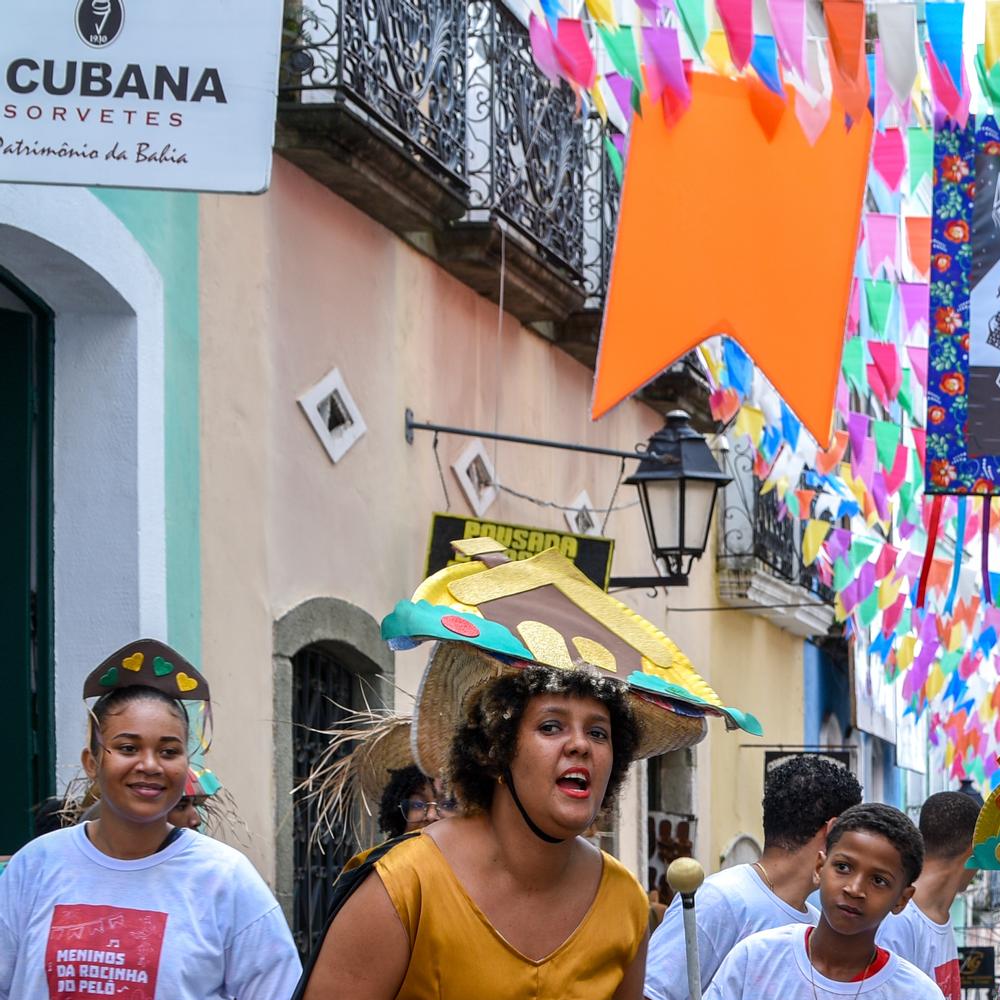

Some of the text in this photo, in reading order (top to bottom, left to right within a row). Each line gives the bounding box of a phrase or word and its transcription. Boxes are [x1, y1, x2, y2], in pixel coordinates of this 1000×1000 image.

[6, 57, 228, 104] CUBANA
[4, 104, 183, 127] SORVETES
[105, 142, 128, 161] da
[136, 142, 189, 164] Bahia
[464, 520, 577, 558] POUSADA
[57, 950, 125, 965] MENINOS
[57, 964, 148, 983] DA ROCINHA
[79, 980, 115, 995] PELÔ
